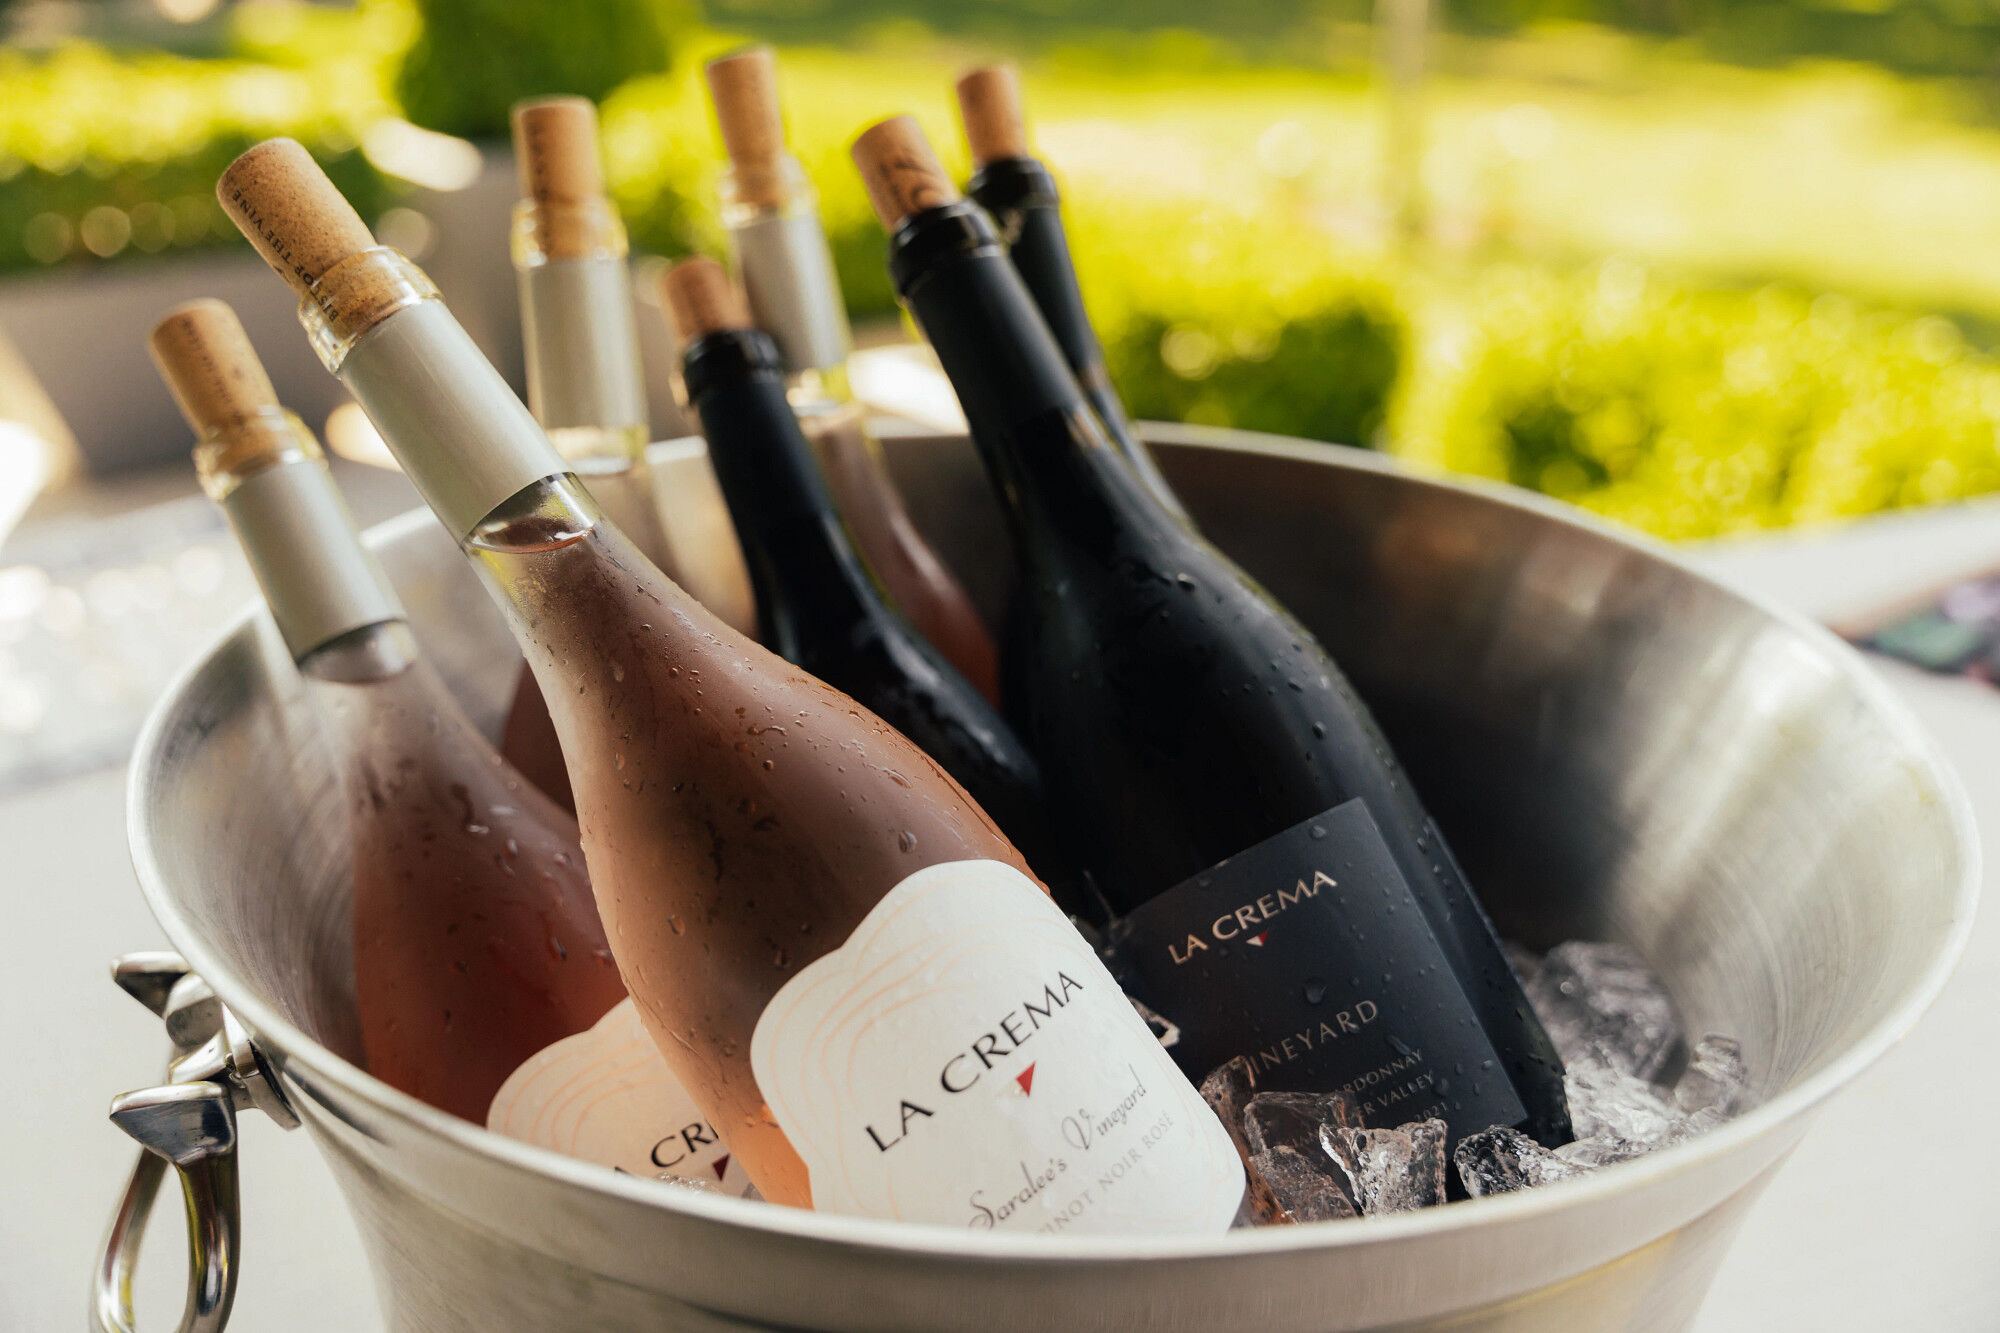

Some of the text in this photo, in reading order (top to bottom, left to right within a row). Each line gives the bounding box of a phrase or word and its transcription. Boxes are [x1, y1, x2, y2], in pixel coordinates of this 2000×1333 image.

[232, 190, 265, 231] VINE
[265, 230, 291, 265] THE
[294, 264, 314, 287] OF
[1168, 870, 1338, 965] LA CREMA
[1250, 1000, 1378, 1075] INEYARD
[864, 970, 1085, 1153] LA CREMA
[1344, 1049, 1423, 1094] RDONNAY
[1377, 1070, 1435, 1108] VALLEY
[968, 1063, 1147, 1230] Saralee's Vineyard
[1098, 1148, 1144, 1192] NOIR
